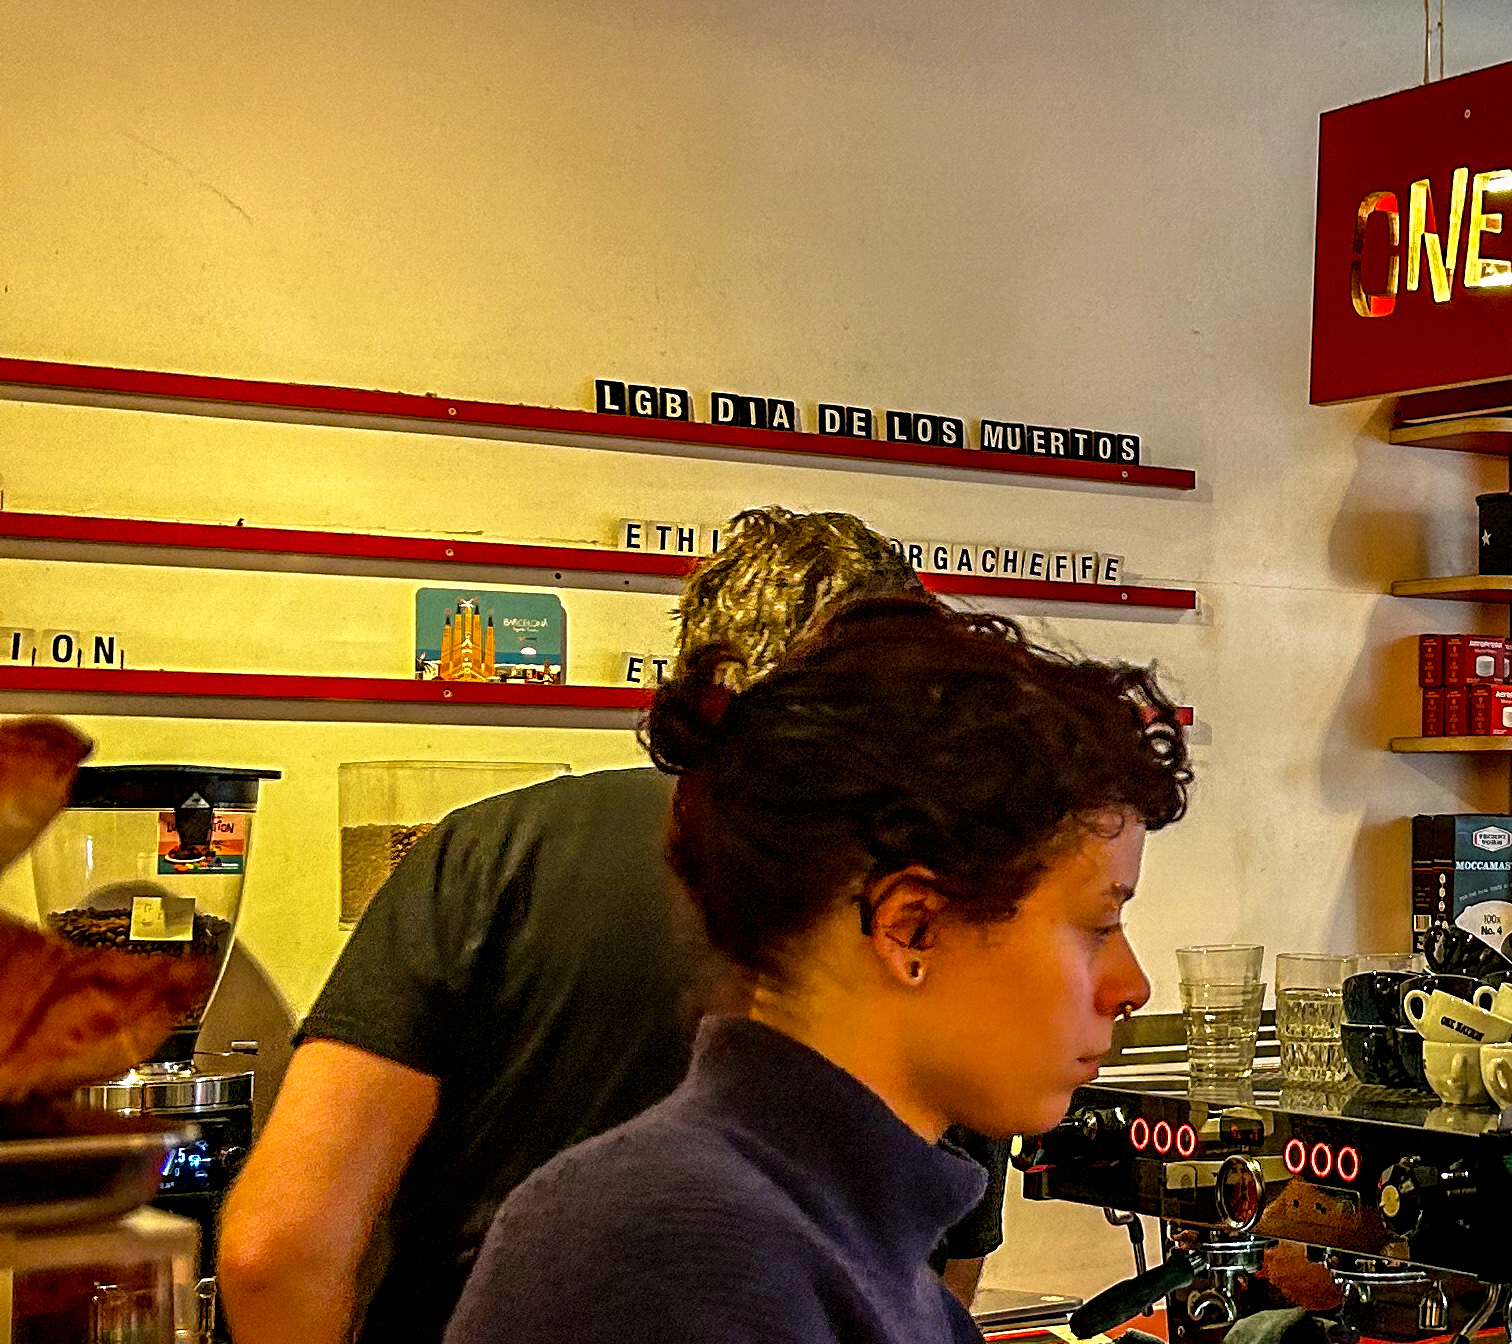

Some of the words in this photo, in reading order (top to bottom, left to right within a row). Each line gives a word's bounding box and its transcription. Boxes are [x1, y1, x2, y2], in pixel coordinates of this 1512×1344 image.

[603, 385, 683, 419] LGB
[718, 397, 790, 428] DIA
[825, 409, 867, 436] DE
[894, 416, 957, 444] LOS
[984, 424, 1135, 461] MUERTOS
[626, 523, 719, 554] ETHI
[890, 538, 1120, 582] RGACHEFFE
[626, 656, 668, 684] ET
